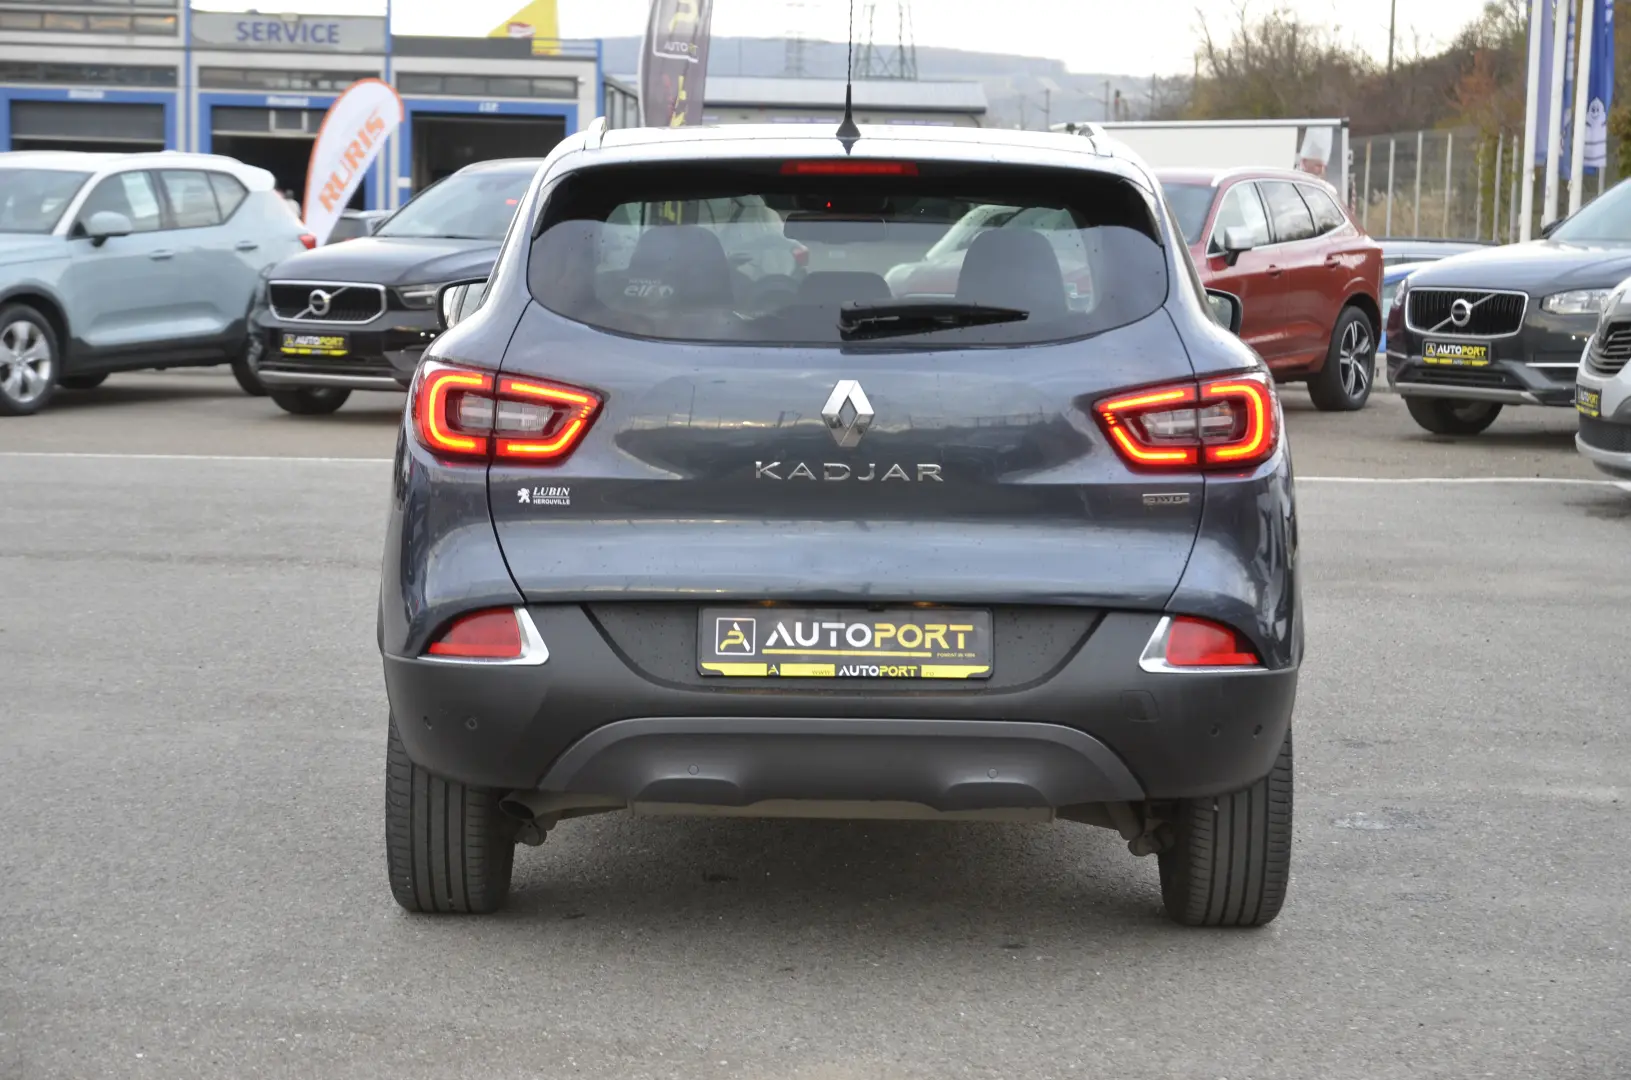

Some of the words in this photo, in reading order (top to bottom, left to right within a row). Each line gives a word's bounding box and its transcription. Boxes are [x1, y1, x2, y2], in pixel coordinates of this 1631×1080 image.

[236, 21, 340, 43] SERVICE
[319, 107, 385, 214] RURIS
[1437, 343, 1487, 357] AUTOPORT
[755, 461, 944, 483] KADJAR
[532, 487, 570, 496] LUBIN
[765, 621, 974, 650] AUTOPORT
[838, 664, 918, 678] AUTOPORT
